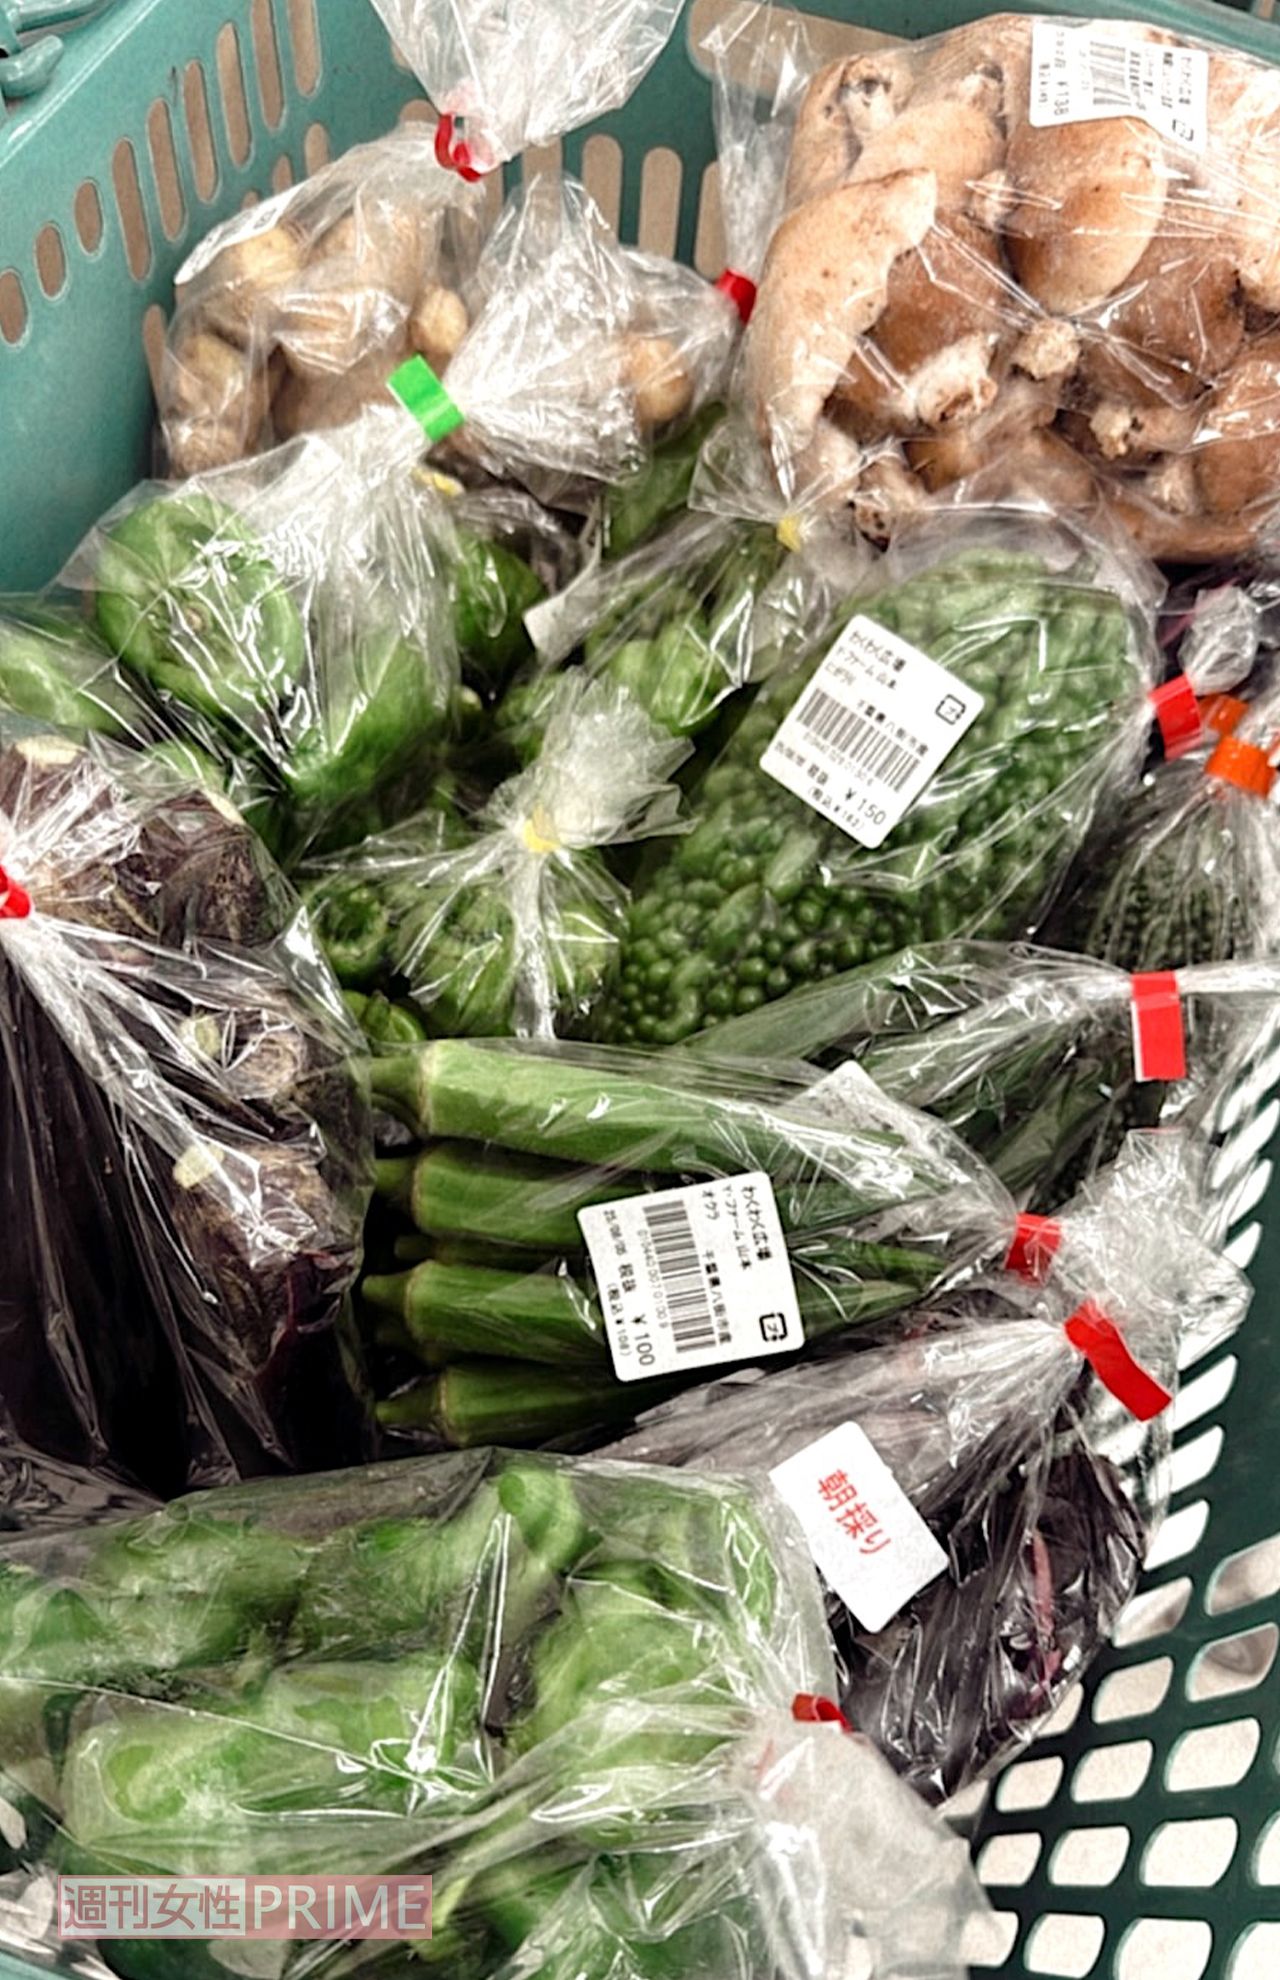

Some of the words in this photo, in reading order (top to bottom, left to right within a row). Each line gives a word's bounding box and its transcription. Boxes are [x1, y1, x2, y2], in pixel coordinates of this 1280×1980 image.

[702, 1190, 720, 1220] オクラ
[741, 1186, 773, 1261] わくわく広場
[817, 1468, 892, 1555] 朝採り
